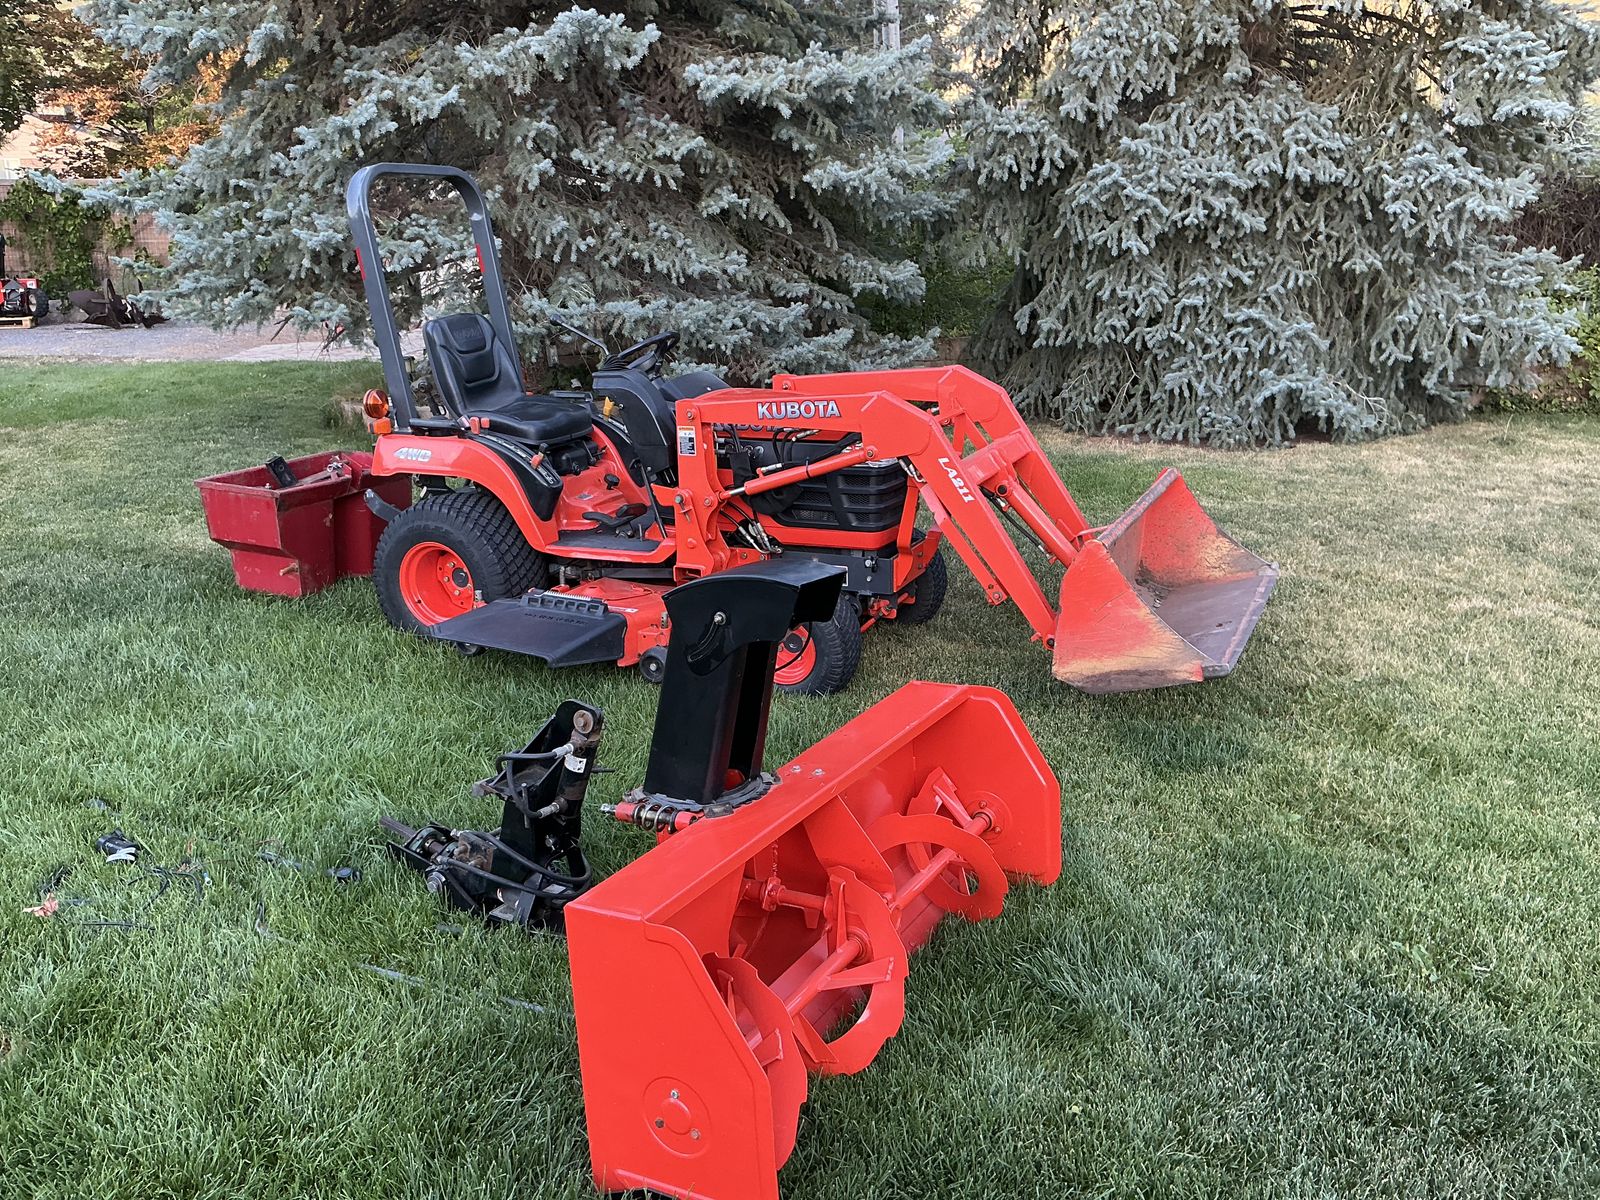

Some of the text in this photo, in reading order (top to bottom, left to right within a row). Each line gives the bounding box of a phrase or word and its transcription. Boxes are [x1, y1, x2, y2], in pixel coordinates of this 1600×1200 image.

[757, 400, 841, 420] KUBOTA
[393, 447, 432, 462] 4WD
[937, 457, 975, 503] LA211
